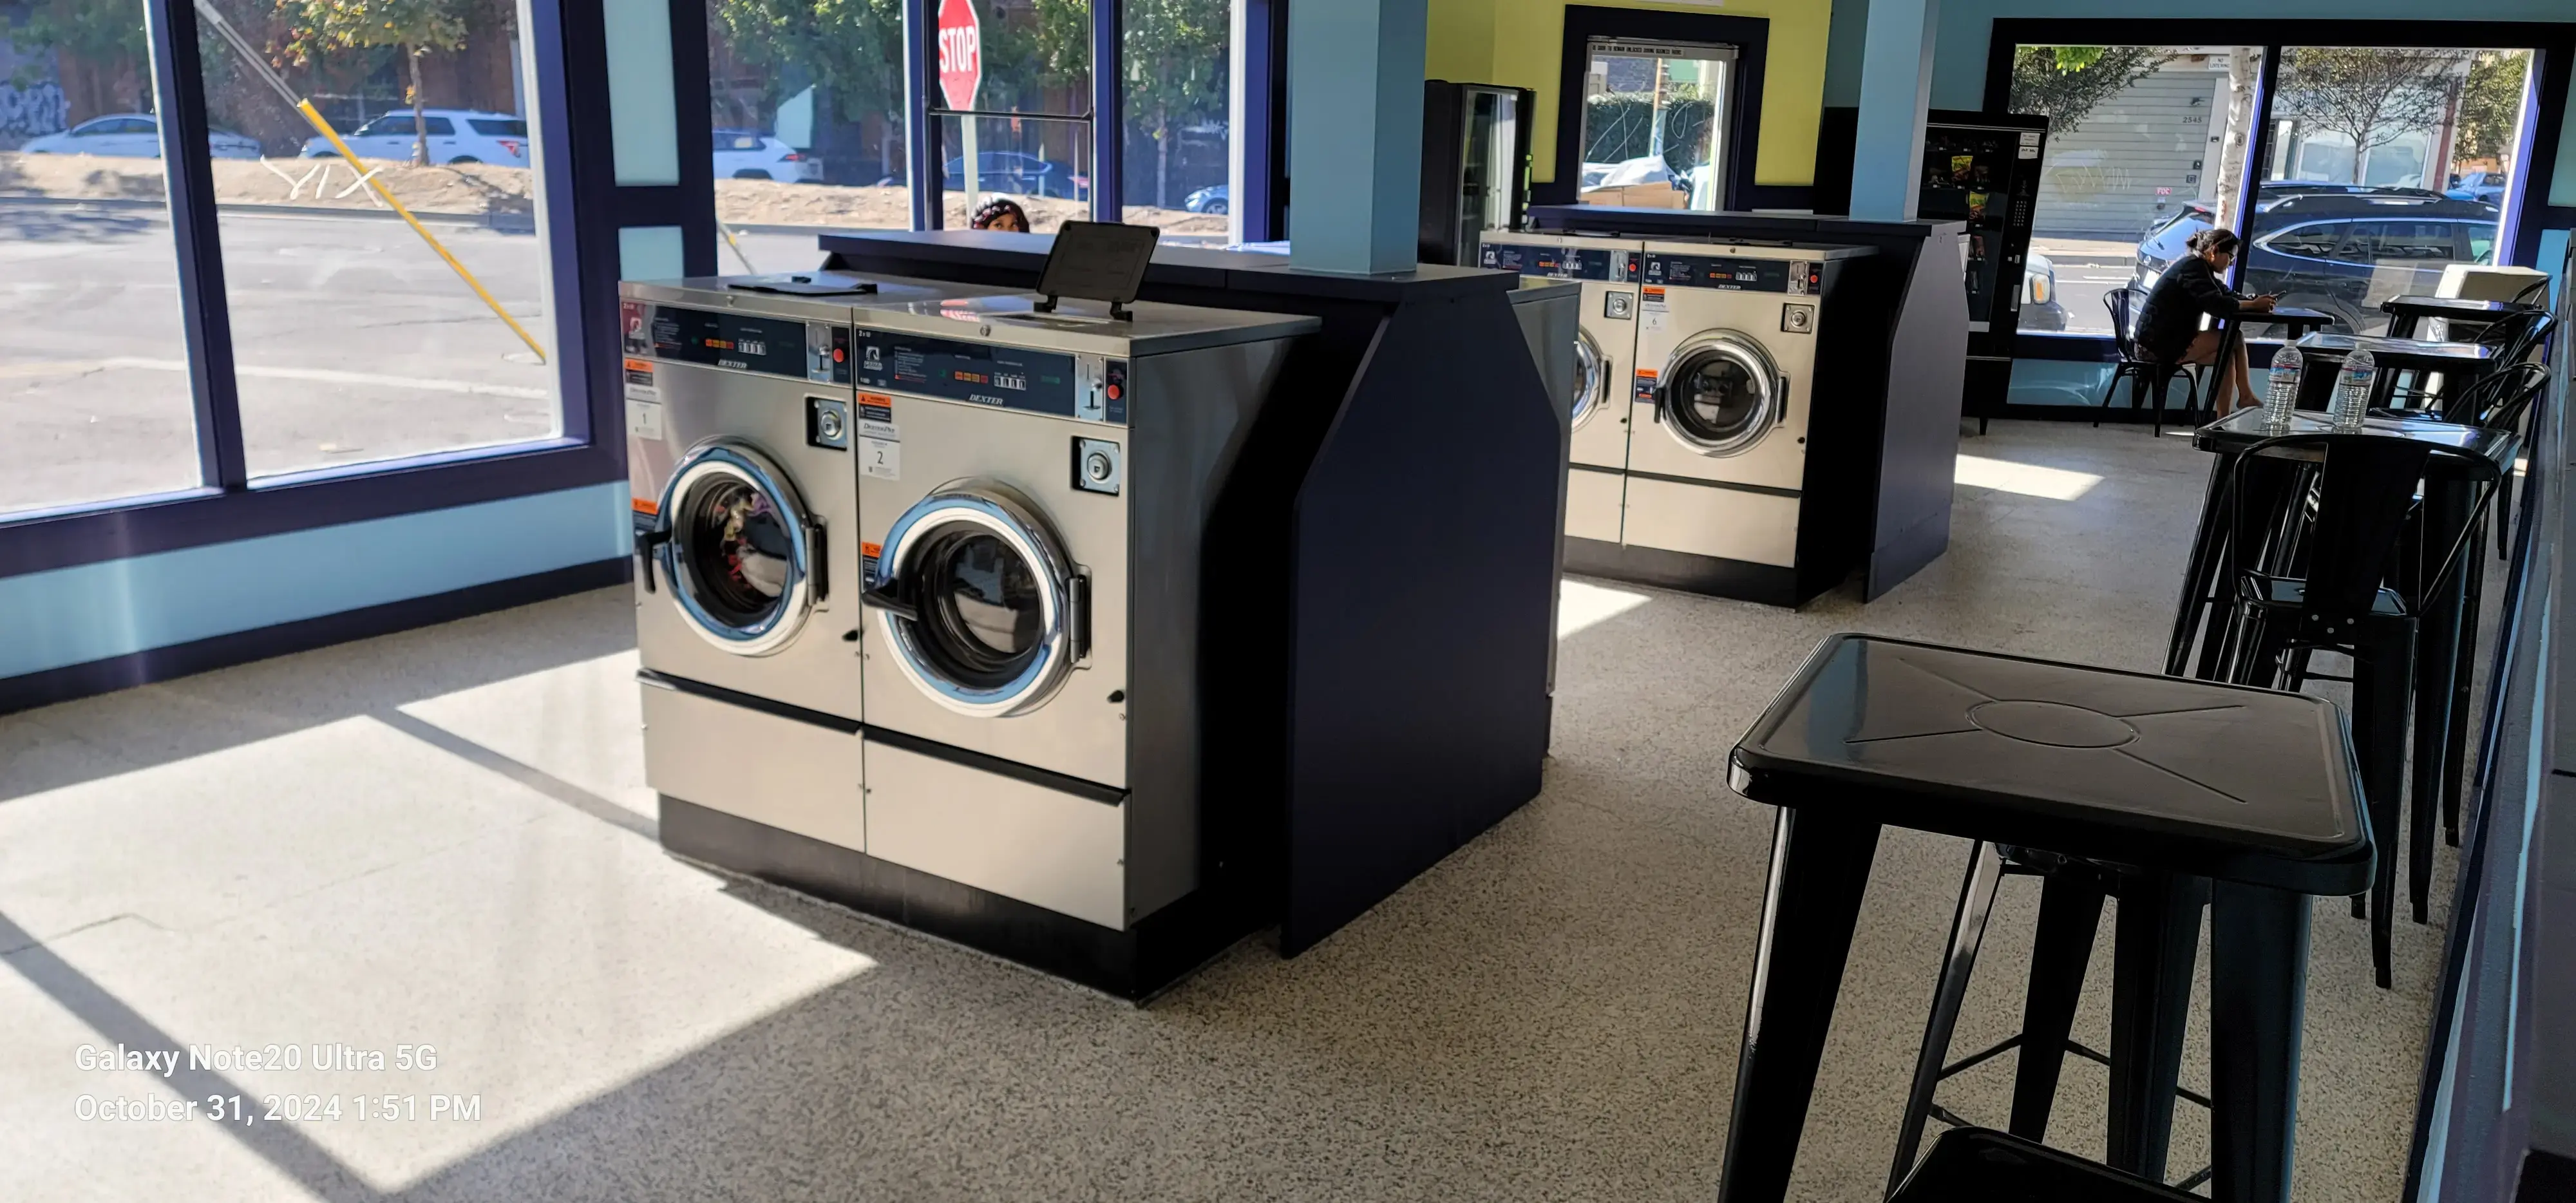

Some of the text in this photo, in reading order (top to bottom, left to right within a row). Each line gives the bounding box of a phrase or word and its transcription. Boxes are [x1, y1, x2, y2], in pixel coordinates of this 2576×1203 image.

[938, 26, 976, 73] STOP
[718, 359, 747, 369] DEXTER
[969, 393, 1003, 406] DEXTER
[643, 413, 647, 425] 1
[877, 451, 884, 465] 2
